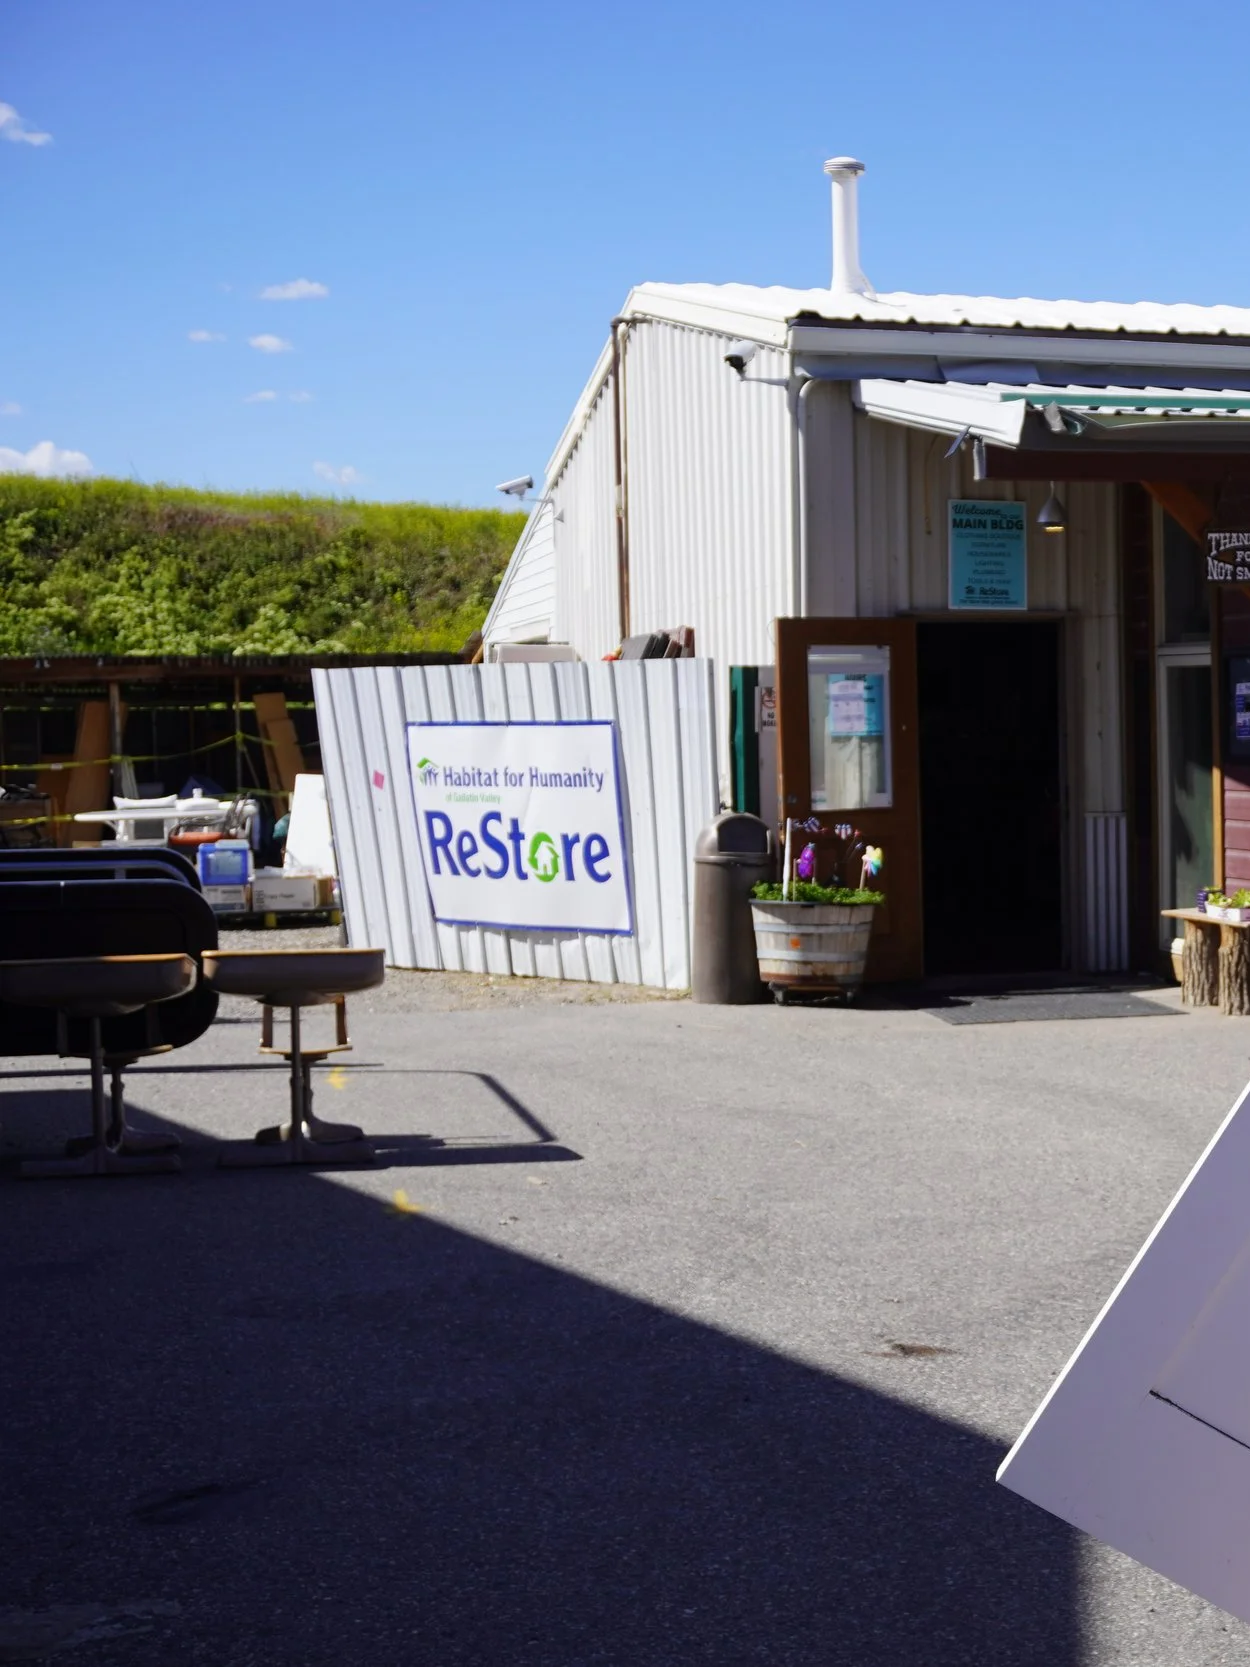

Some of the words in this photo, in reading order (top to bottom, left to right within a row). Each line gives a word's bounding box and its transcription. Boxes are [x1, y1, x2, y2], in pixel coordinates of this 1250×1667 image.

[952, 504, 1001, 516] Welcome
[952, 518, 987, 529] MAIN
[991, 519, 1024, 531] BLDG
[1206, 555, 1234, 580] NOT
[443, 766, 498, 787] Habitat
[504, 766, 524, 787] for
[529, 767, 604, 792] Humanity
[424, 810, 612, 883] ReStore
